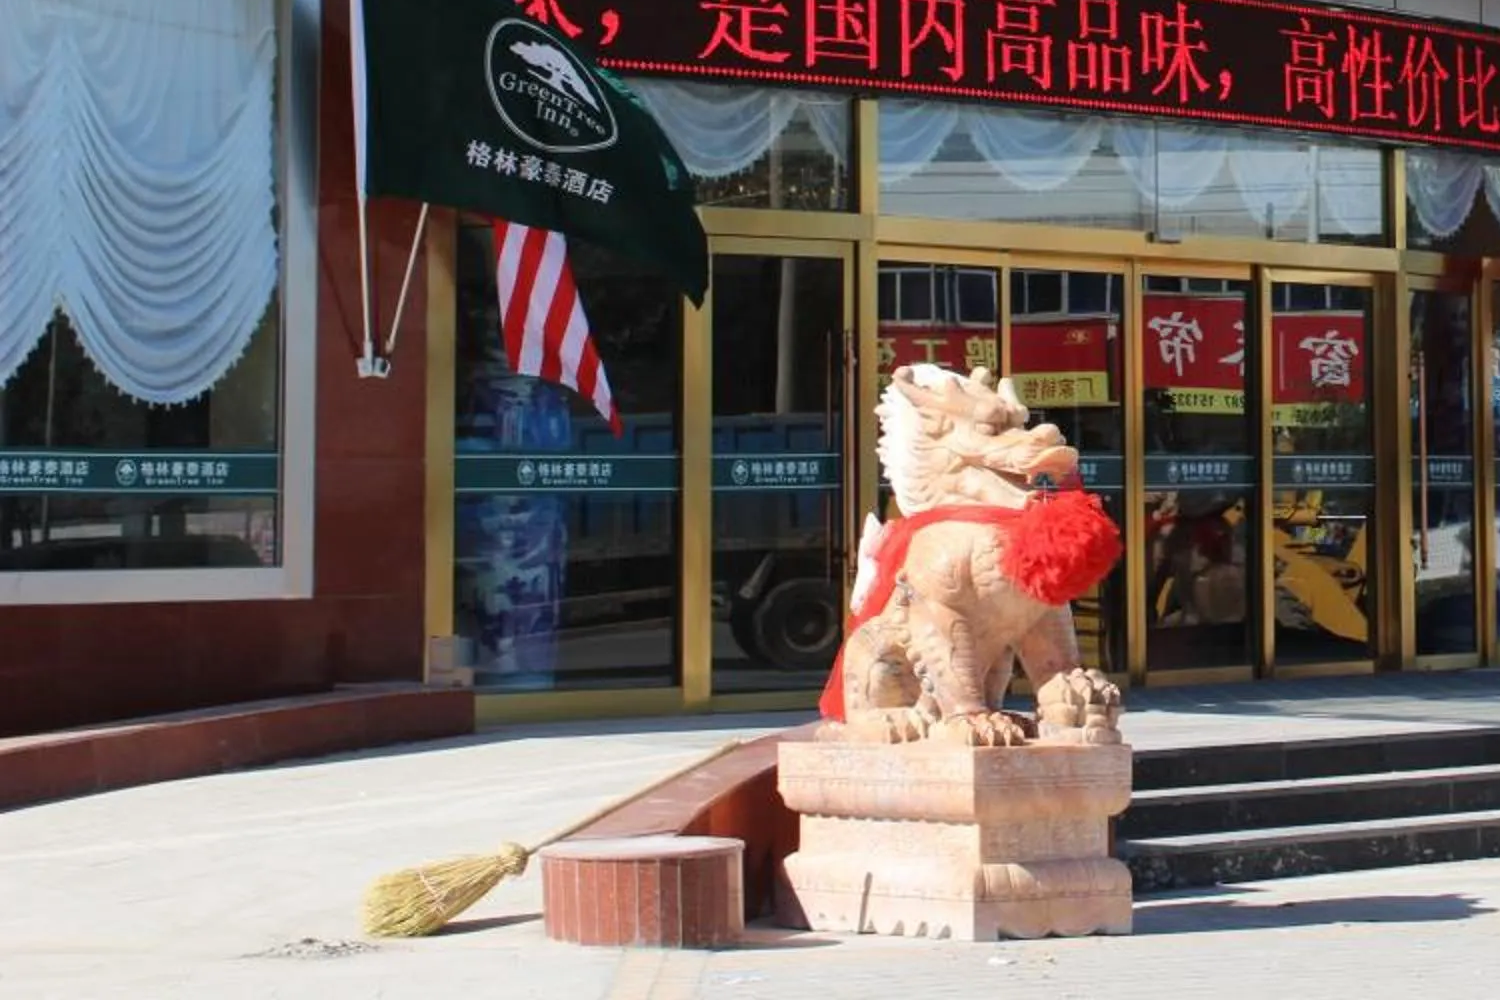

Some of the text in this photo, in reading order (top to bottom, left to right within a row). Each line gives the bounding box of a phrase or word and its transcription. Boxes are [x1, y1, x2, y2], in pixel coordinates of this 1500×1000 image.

[500, 71, 606, 135] GreenTree
[466, 139, 614, 203] 格林豪泰酒店
